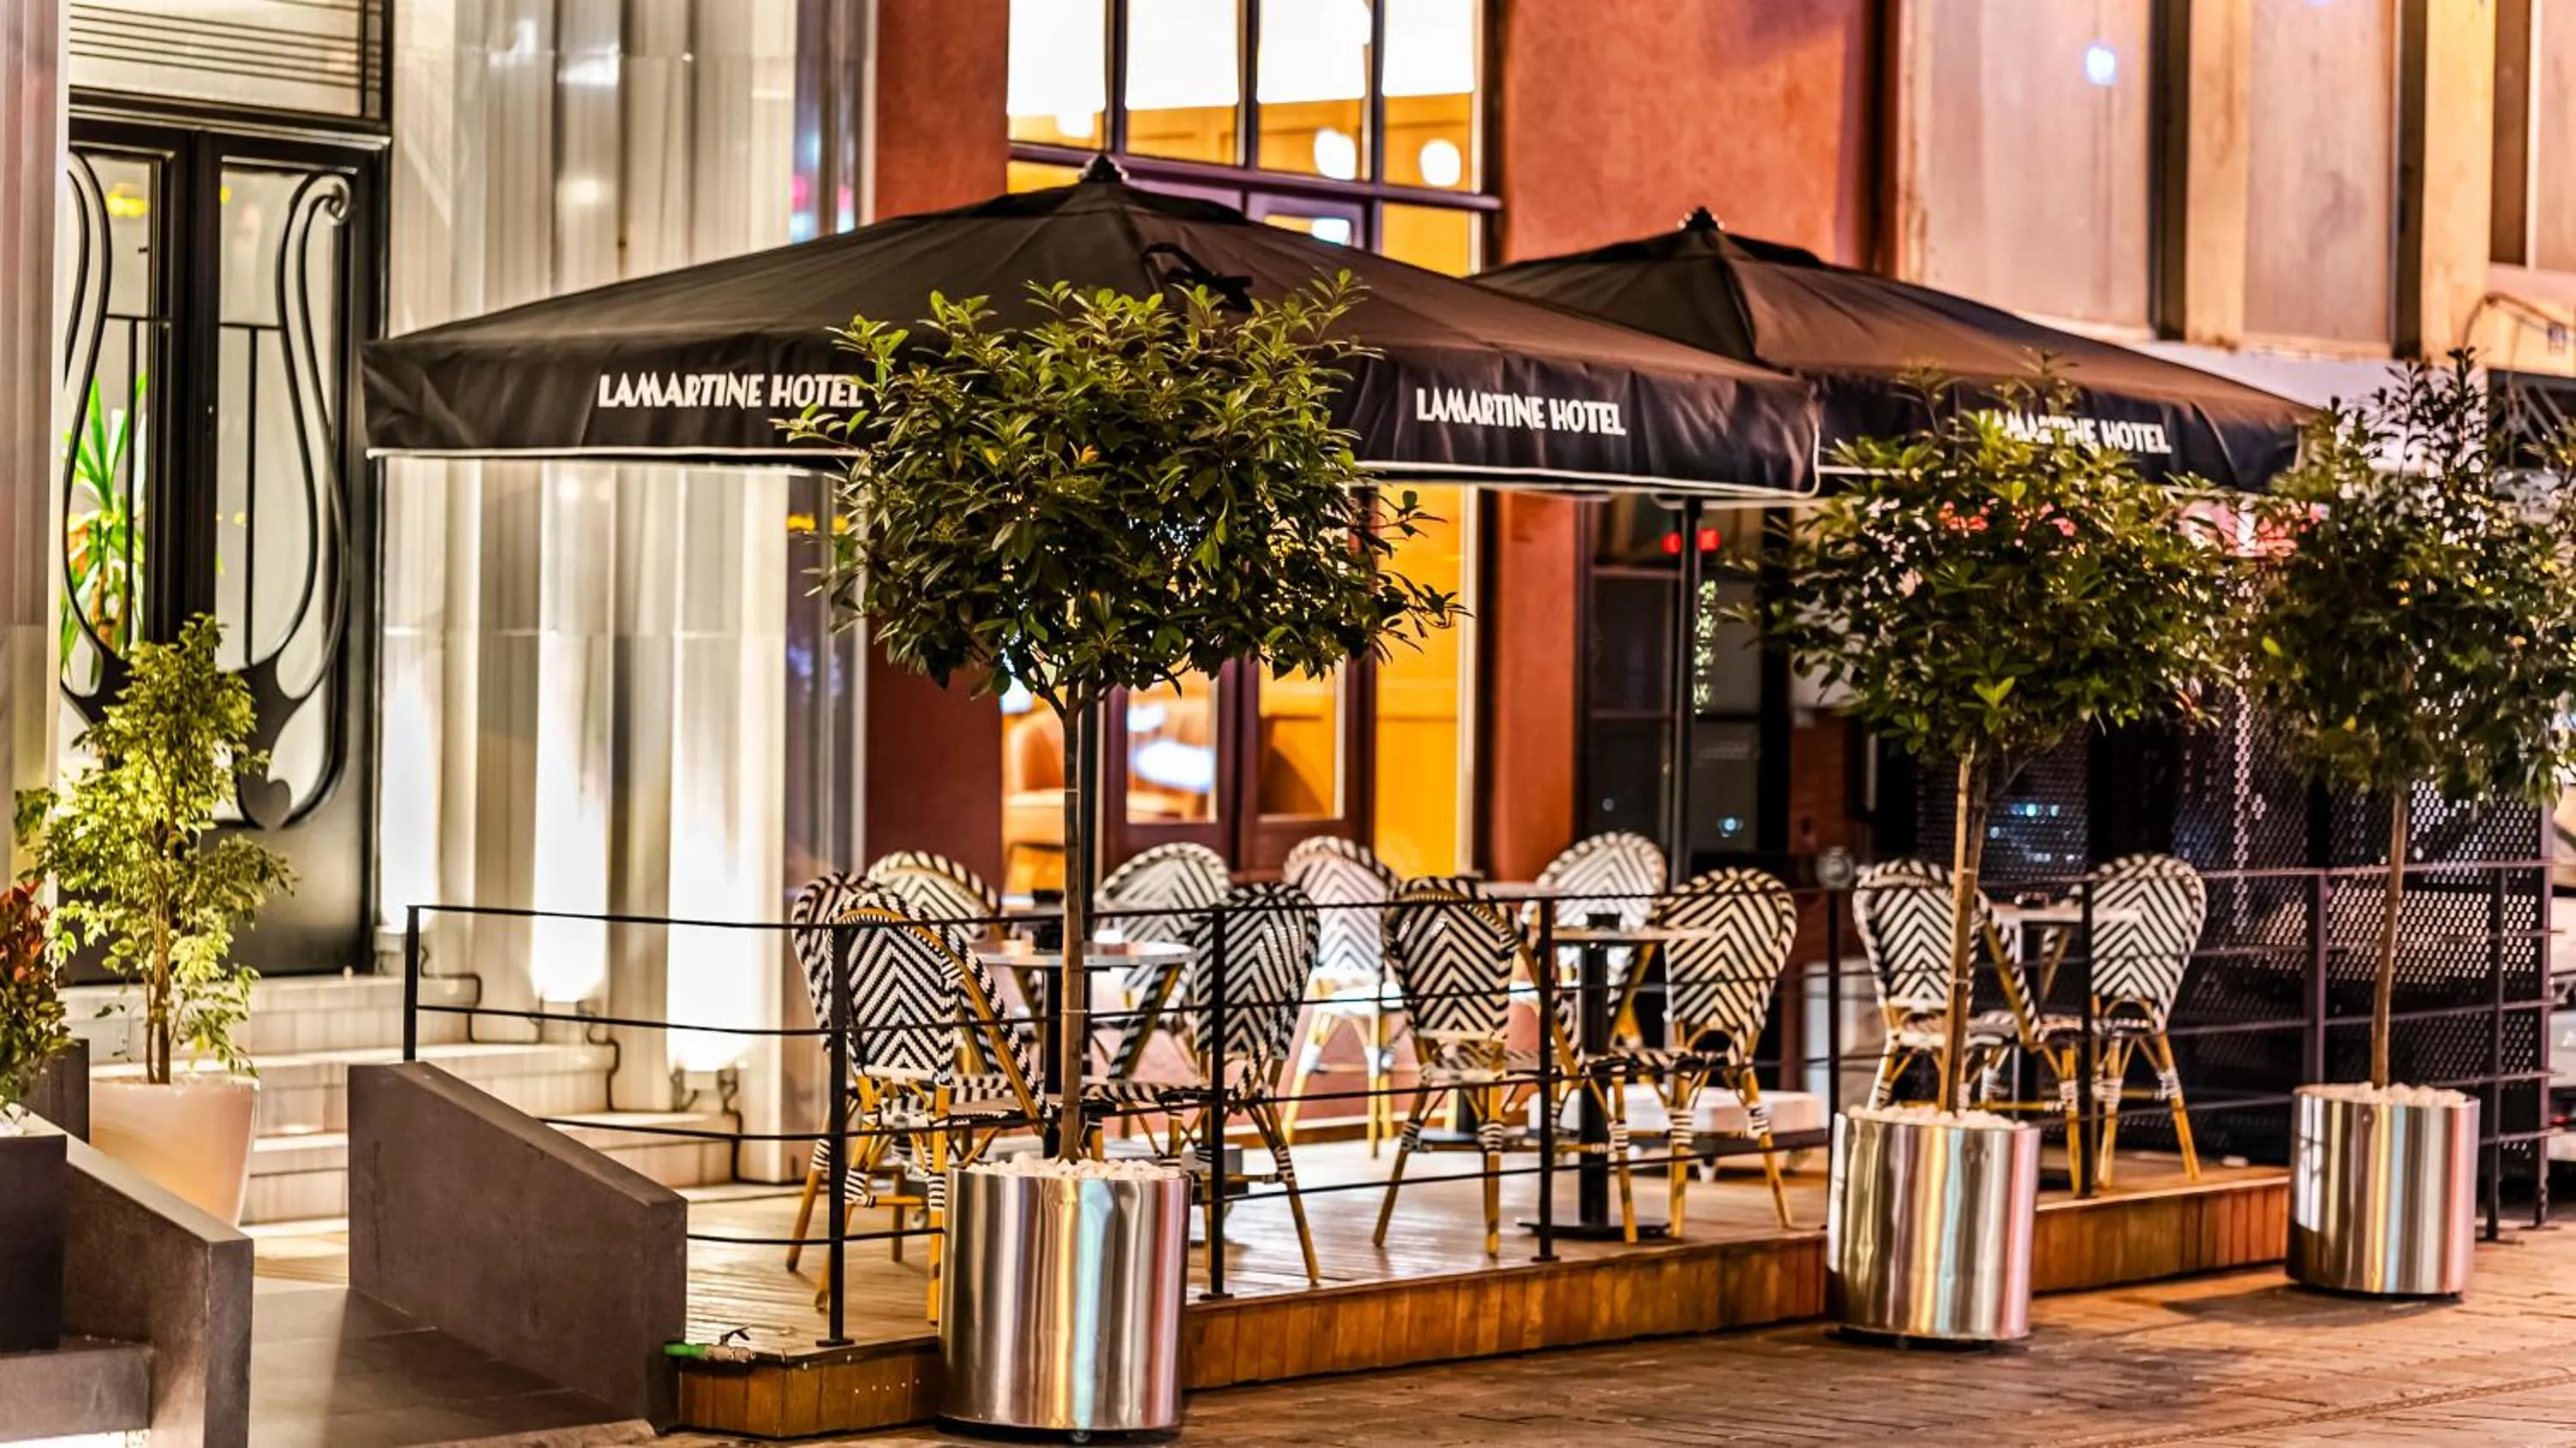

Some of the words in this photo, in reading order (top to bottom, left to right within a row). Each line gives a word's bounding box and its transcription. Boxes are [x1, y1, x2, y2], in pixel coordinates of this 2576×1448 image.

[598, 372, 764, 409] LAMARTINE
[769, 374, 864, 408] HOTEL
[1416, 387, 1546, 429] LAMARTINE
[1549, 398, 1626, 435] HOTEL
[2100, 420, 2172, 453] HOTEL
